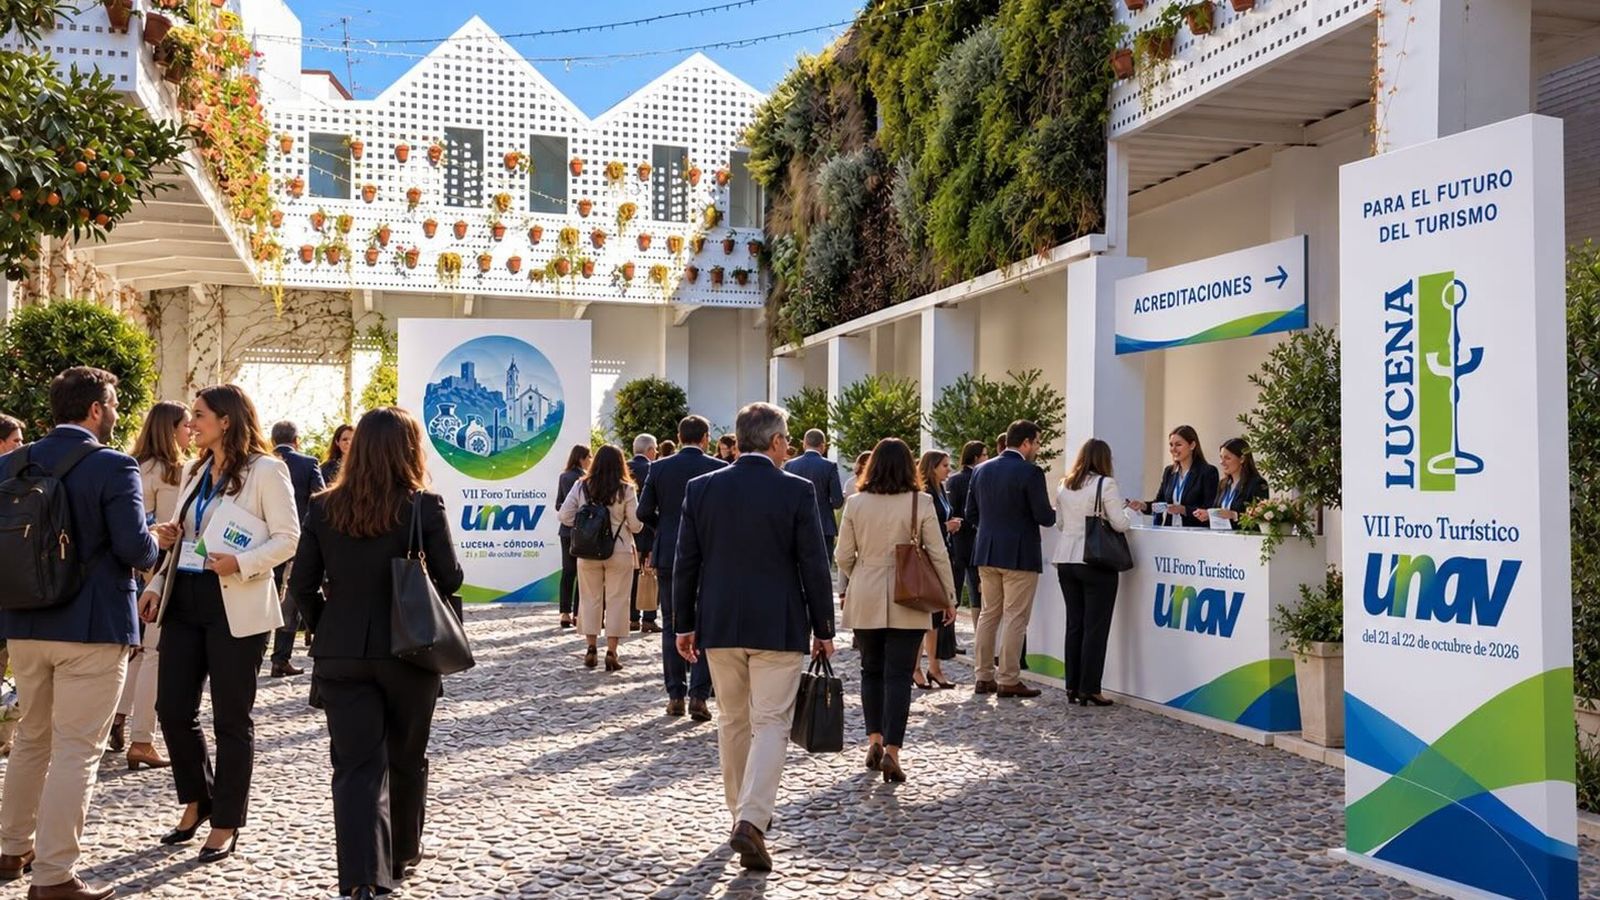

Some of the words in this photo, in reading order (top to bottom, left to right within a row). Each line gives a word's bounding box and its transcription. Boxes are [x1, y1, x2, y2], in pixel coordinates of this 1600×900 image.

[1363, 194, 1405, 218] PARA
[1411, 189, 1431, 208] EL
[1437, 169, 1513, 202] FUTURO
[1379, 222, 1410, 243] DEL
[1415, 203, 1498, 235] TURISMO
[1134, 275, 1252, 315] ACREDITACIONES
[1384, 278, 1415, 489] LUCENA
[462, 489, 478, 499] VII
[480, 488, 503, 499] Foro
[1363, 515, 1390, 538] VII
[1394, 516, 1433, 539] Foro
[1436, 516, 1520, 542] Turístico
[1155, 556, 1171, 574] VII
[1173, 558, 1196, 576] Foro
[1198, 559, 1245, 580] Turístico
[1362, 628, 1377, 644] del
[1378, 630, 1390, 645] 21
[1391, 632, 1400, 646] al
[1402, 632, 1415, 648] 22
[1418, 634, 1430, 649] de
[1432, 637, 1472, 654] octubre
[1474, 640, 1486, 656] de
[1489, 642, 1520, 660] 2026
